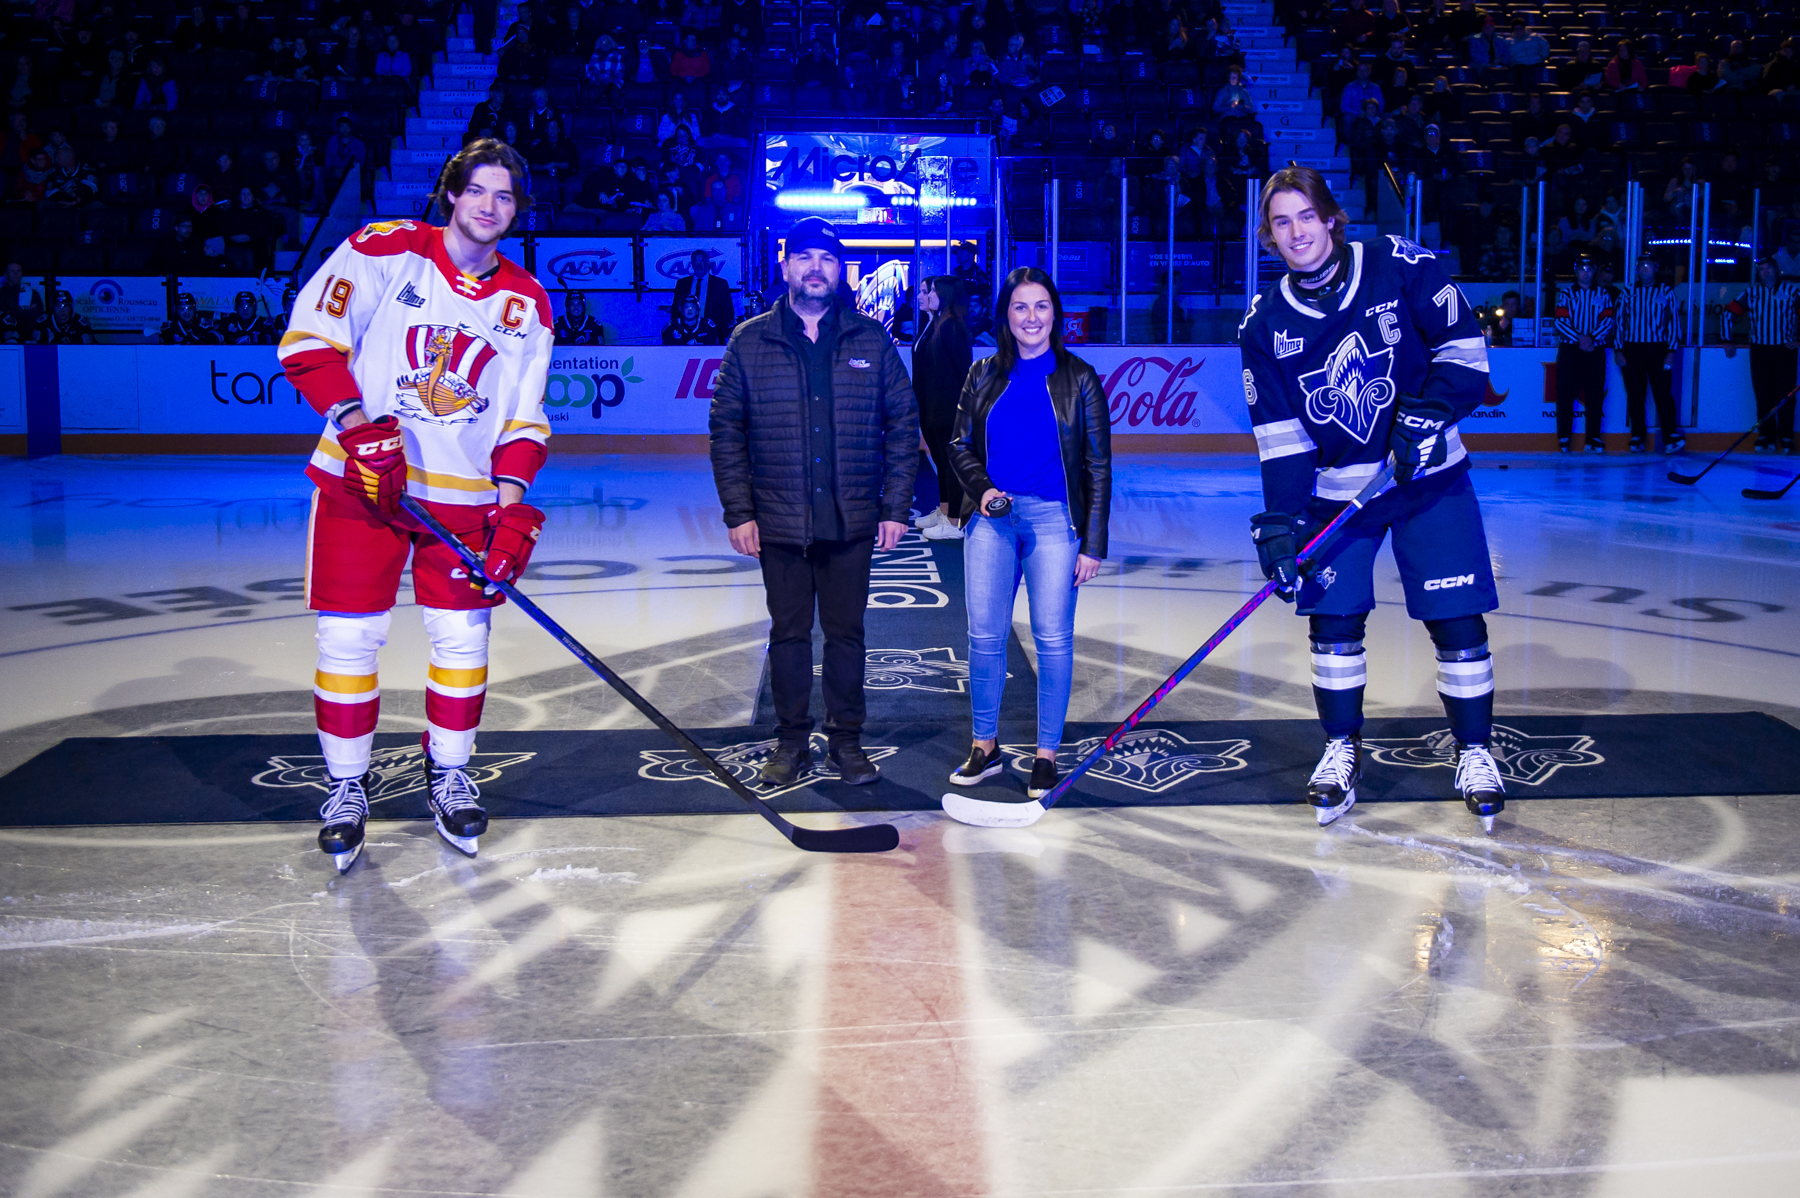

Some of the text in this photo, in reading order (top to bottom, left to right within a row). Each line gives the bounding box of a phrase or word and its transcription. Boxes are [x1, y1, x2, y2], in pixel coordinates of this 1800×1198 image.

[1237, 17, 1244, 25] K
[467, 80, 475, 89] H
[1269, 89, 1277, 98] H
[453, 107, 462, 117] G
[1280, 116, 1290, 126] G
[442, 137, 450, 147] F
[1294, 145, 1302, 155] F
[770, 147, 979, 183] MicroAe
[427, 168, 435, 178] E
[413, 201, 422, 211] D
[560, 260, 618, 275] A&W
[118, 298, 158, 306] Rousseau
[315, 274, 355, 319] 19
[501, 295, 527, 329] C
[1366, 299, 1399, 317] CCM
[1432, 284, 1459, 327] 7
[493, 325, 528, 340] CCM
[1378, 311, 1402, 345] C
[674, 358, 725, 399] IG
[545, 373, 626, 419] oop
[546, 412, 569, 421] uski
[355, 434, 403, 456] CC
[1424, 573, 1475, 591] CCM
